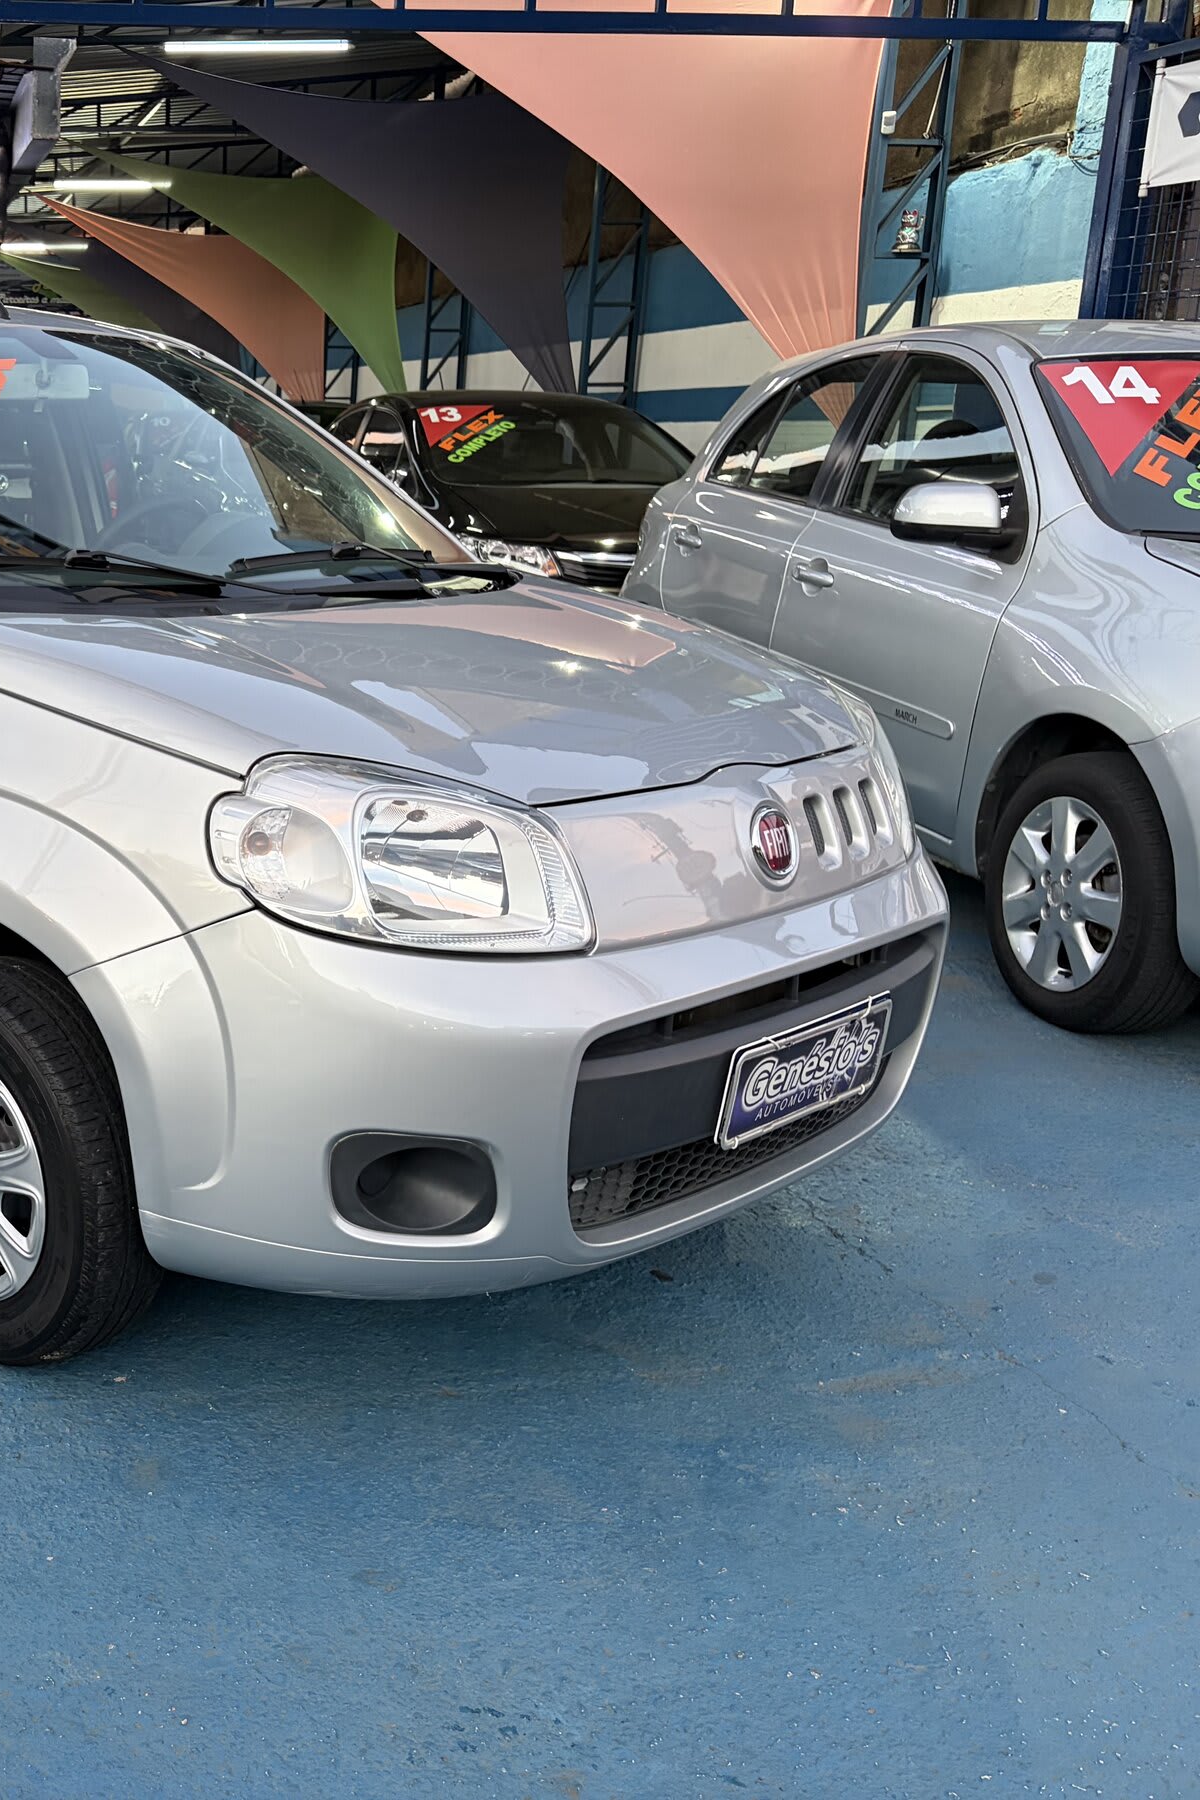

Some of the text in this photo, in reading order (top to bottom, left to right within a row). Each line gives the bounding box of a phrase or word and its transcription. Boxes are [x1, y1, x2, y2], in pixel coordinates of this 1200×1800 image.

[1061, 365, 1161, 404] 14
[420, 406, 462, 423] 13
[438, 410, 504, 452] FLEX
[447, 420, 516, 463] COMPLETO
[1132, 389, 1200, 487] FLE
[894, 708, 918, 725] MARCH
[763, 826, 789, 860] FIAT
